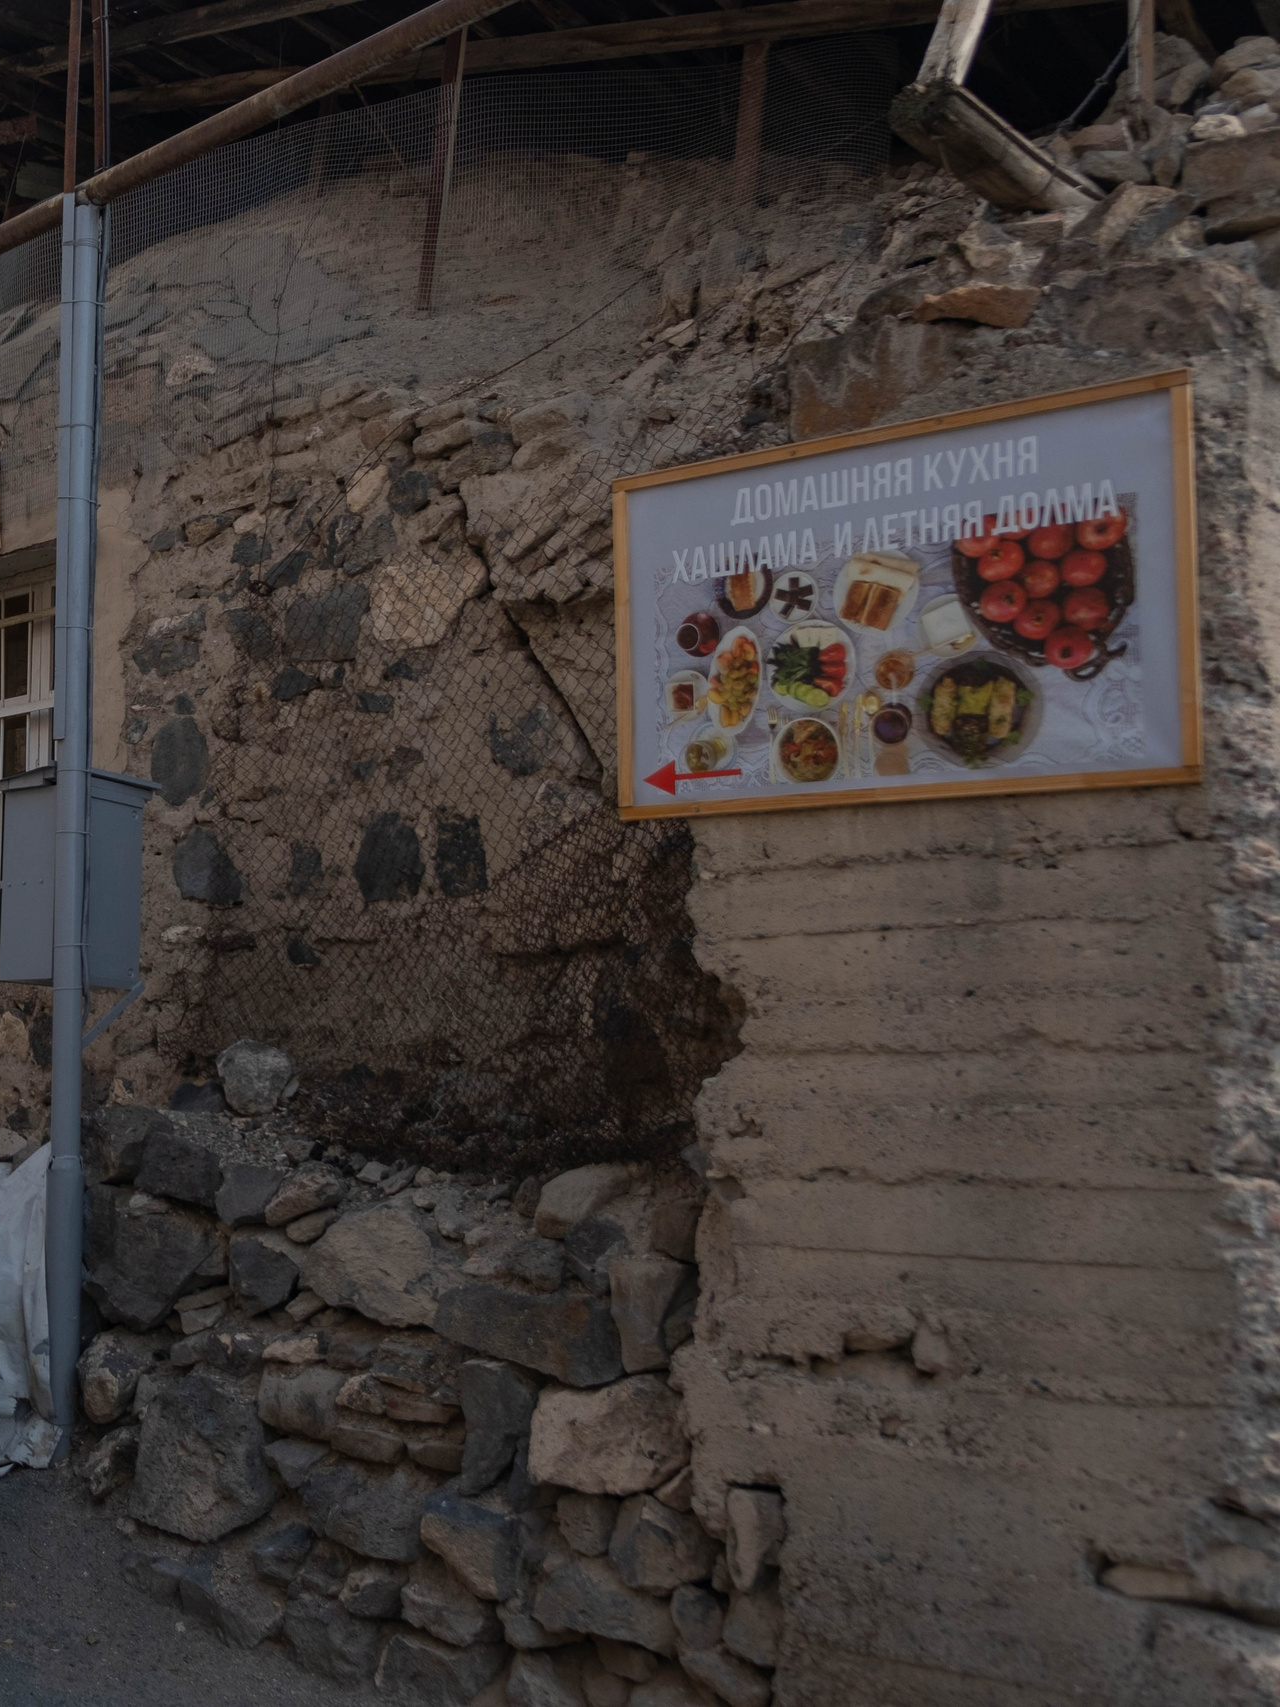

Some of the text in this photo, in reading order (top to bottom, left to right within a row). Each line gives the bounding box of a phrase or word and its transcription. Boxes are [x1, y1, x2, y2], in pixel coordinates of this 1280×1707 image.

[730, 435, 1039, 527] ДОМАШНЯЯ КУХНЯ
[672, 479, 1120, 584] ХАШЛАМА И ЛЕТНЯЯ ДОЛМА
